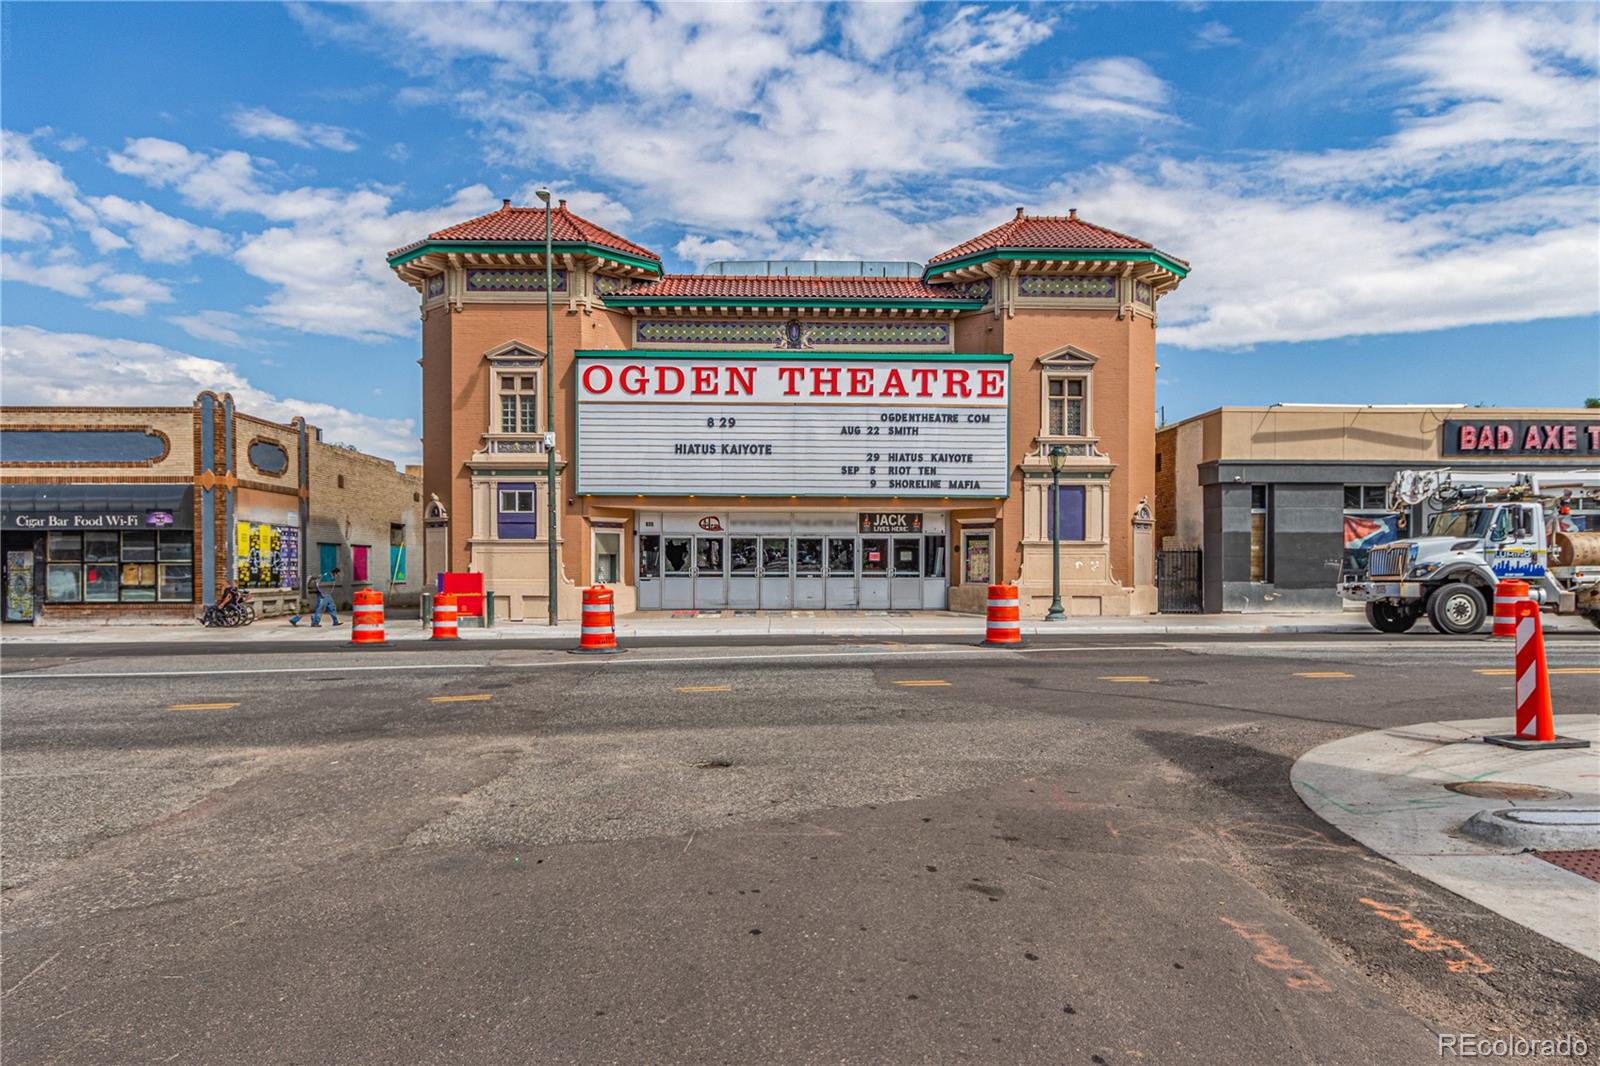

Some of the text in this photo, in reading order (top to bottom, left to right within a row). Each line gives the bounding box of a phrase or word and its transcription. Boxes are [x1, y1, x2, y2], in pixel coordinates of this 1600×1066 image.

[582, 364, 1005, 399] OGDEN THEATRE
[706, 417, 736, 428] 8 29
[880, 413, 991, 423] OGDENTHEATRE COM
[840, 426, 919, 436] AUG 22 SMITH
[1459, 425, 1514, 450] BAD
[1523, 425, 1577, 450] AXE
[674, 443, 773, 455] HIATUS KAIYOTE
[866, 453, 973, 463] 29 HIATUS KAIYOTE
[841, 466, 937, 475] SEP 5 RIOT TEN
[869, 479, 981, 490] 9 SHORELINE MAFIA
[16, 515, 45, 528] Cigar
[48, 515, 69, 526] Bar
[73, 515, 103, 526] Food
[105, 514, 138, 526] Wi-Fi
[873, 513, 907, 526] JACK
